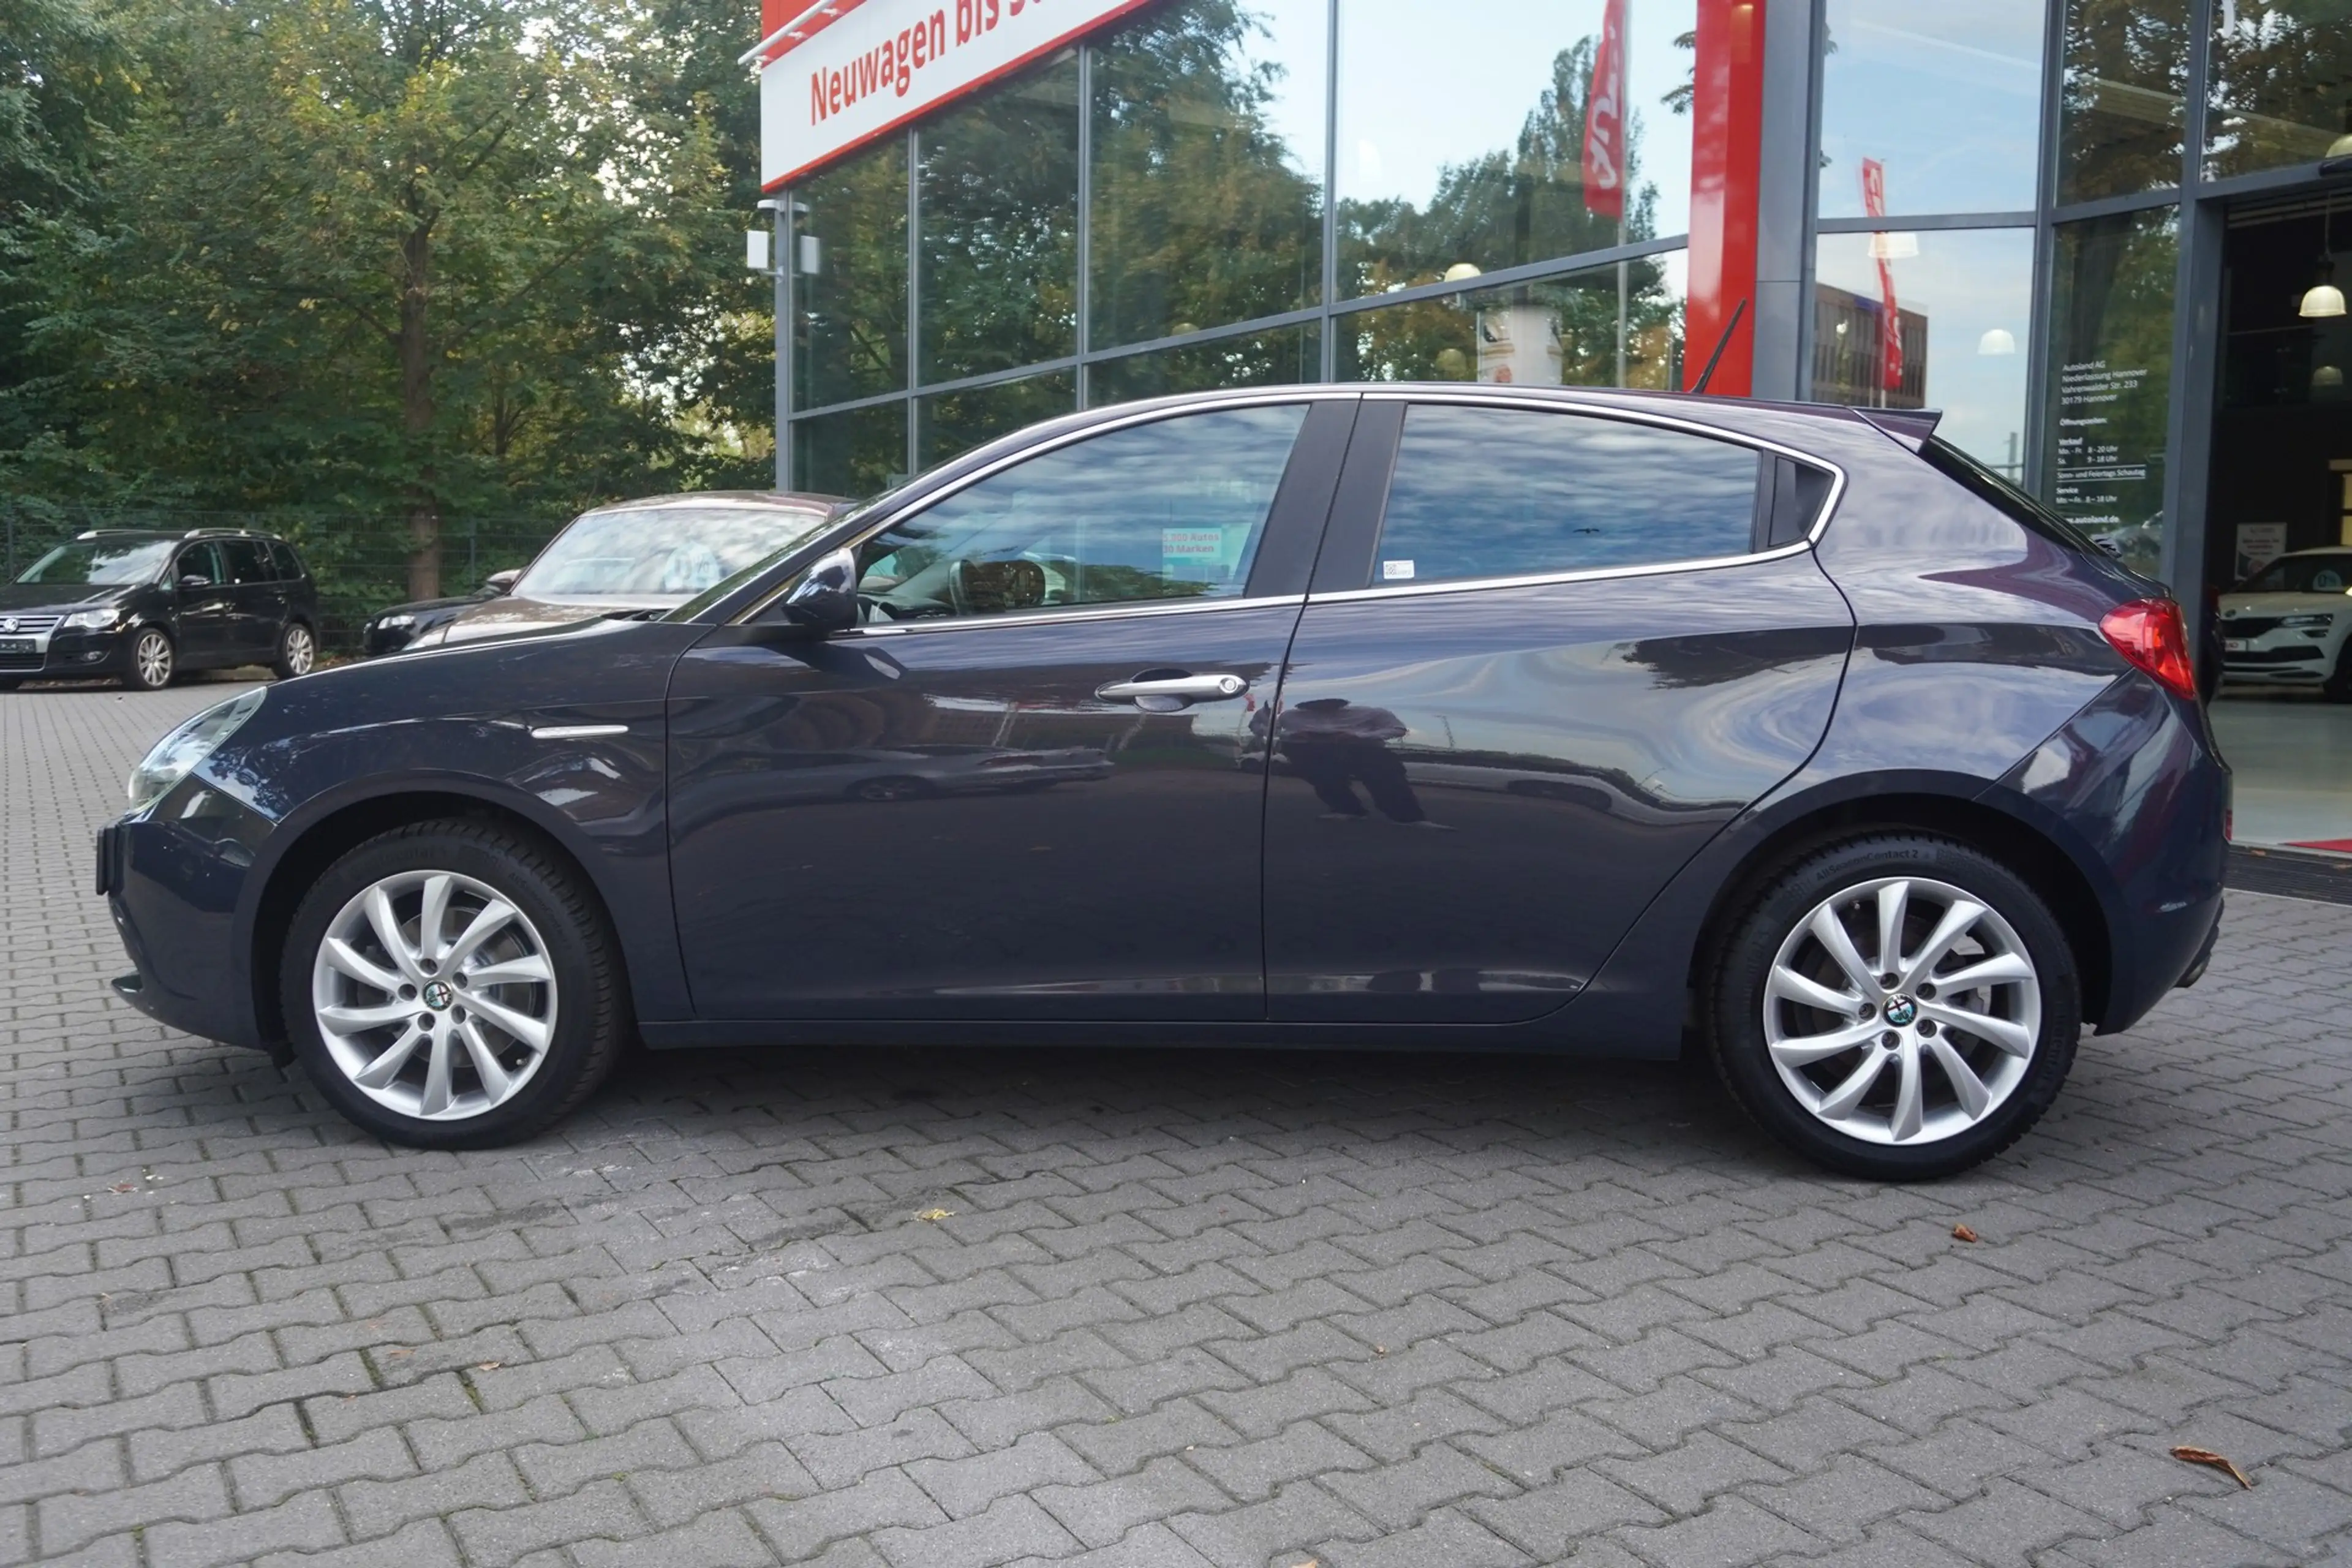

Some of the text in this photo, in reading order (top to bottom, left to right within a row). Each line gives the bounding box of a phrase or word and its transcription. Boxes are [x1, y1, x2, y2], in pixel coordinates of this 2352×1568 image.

[811, 0, 1000, 126] Neuwagen bis
[2062, 360, 2106, 371] Autoland AG
[2062, 369, 2148, 383] Niederlassung Hannover
[2083, 394, 2117, 403] Hannover
[1176, 545, 1215, 553] Marken
